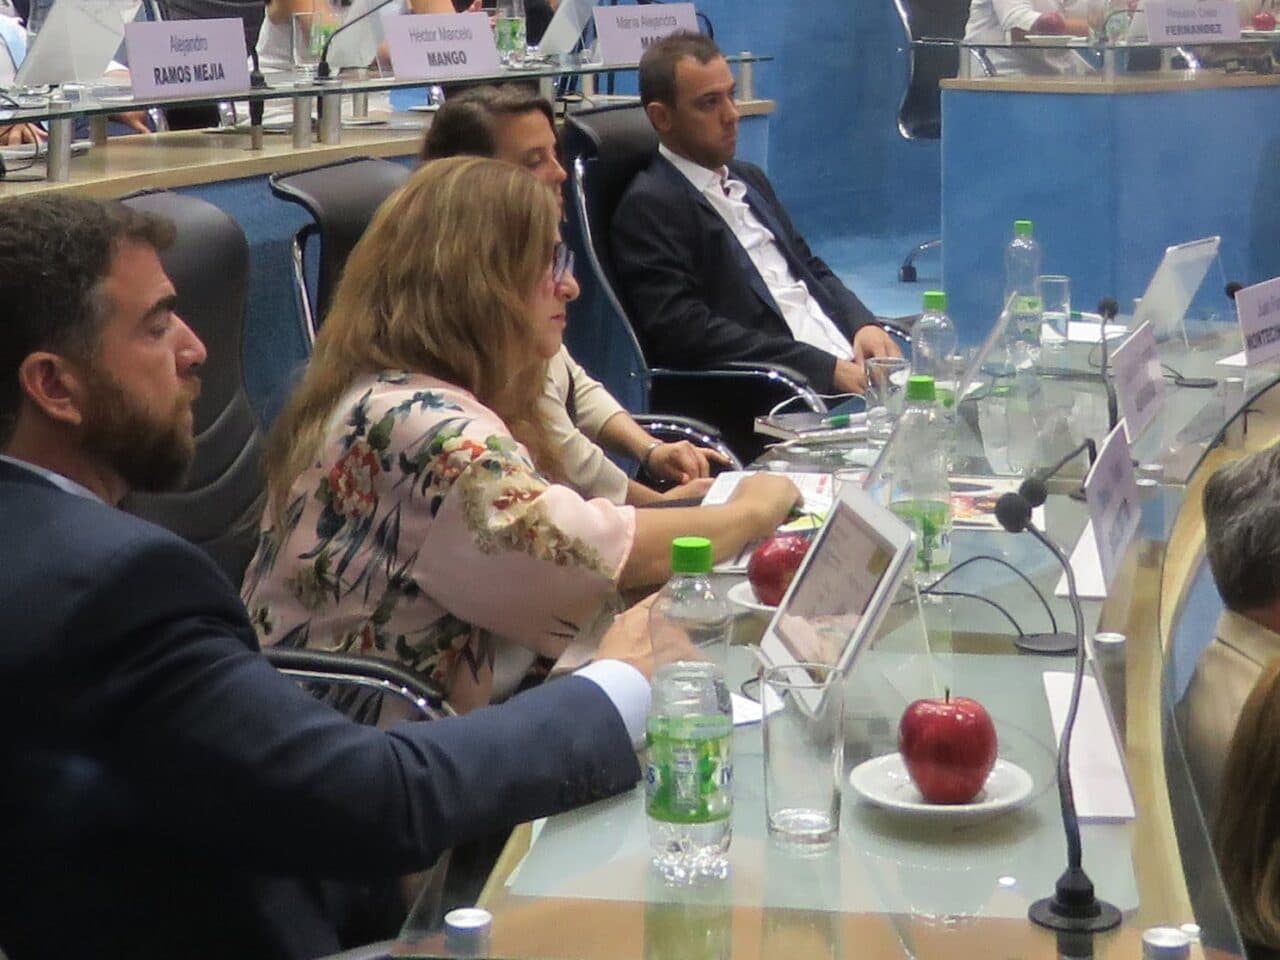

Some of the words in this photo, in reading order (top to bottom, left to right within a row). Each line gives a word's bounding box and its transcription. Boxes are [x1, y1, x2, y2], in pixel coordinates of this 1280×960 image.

[1165, 23, 1223, 36] FERNANDEZ
[169, 33, 209, 57] Alejandro
[426, 50, 468, 67] MANGO
[153, 64, 192, 86] RAMOS
